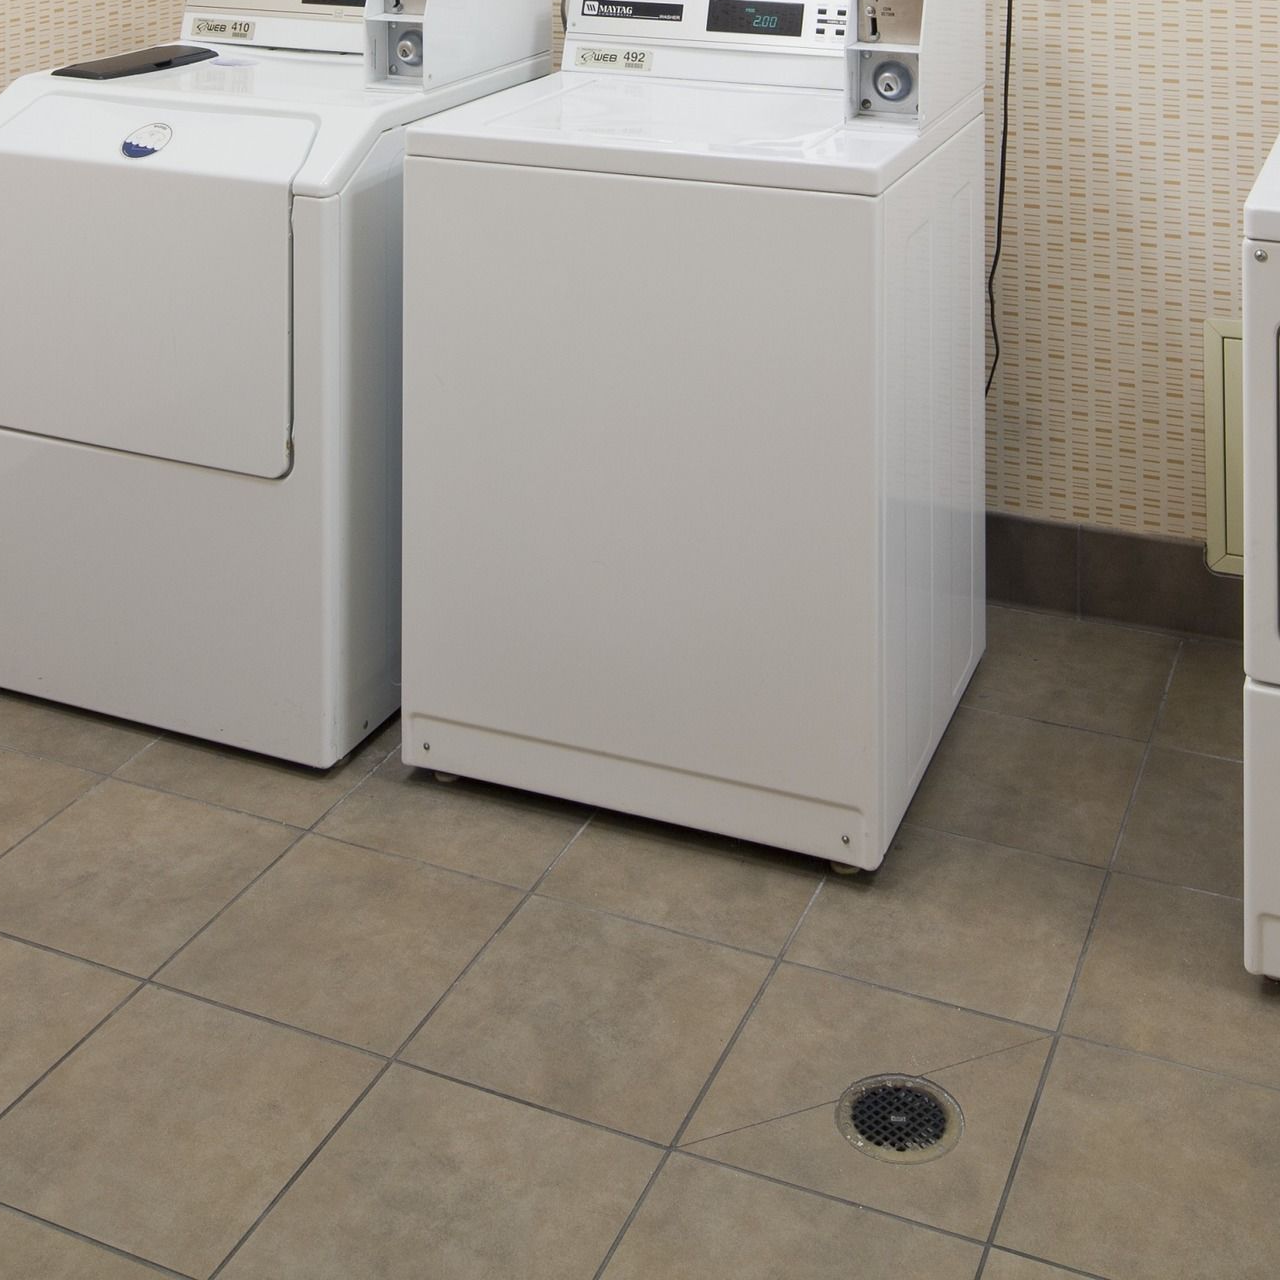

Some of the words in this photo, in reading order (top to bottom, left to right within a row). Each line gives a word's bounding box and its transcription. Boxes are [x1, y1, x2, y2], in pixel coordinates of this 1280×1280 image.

[599, 5, 633, 14] MAYTAG
[207, 23, 227, 32] WEB
[232, 22, 250, 32] 410
[752, 15, 778, 28] 2.00
[593, 52, 618, 62] WEB
[623, 51, 646, 63] 492
